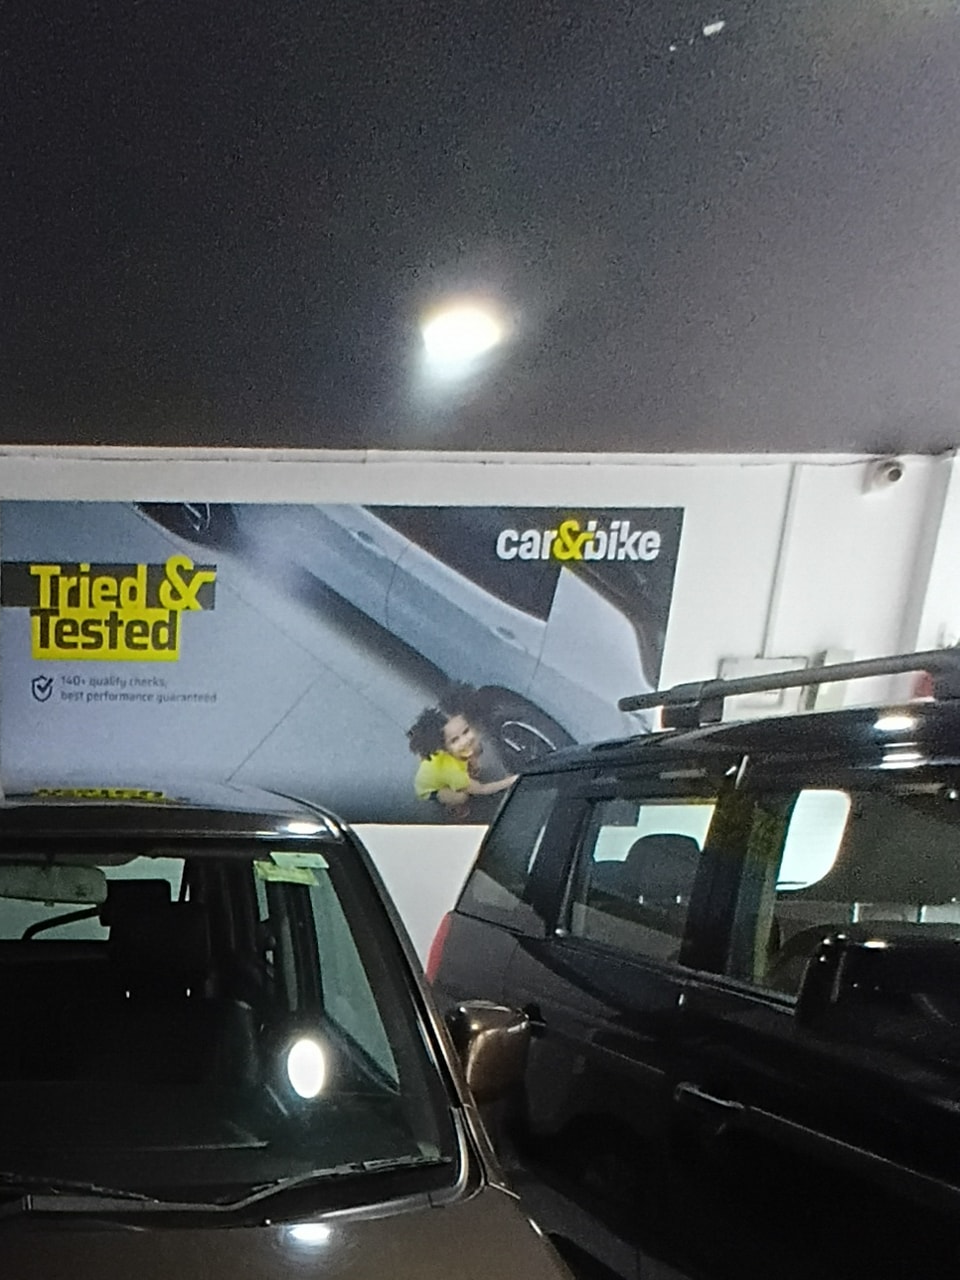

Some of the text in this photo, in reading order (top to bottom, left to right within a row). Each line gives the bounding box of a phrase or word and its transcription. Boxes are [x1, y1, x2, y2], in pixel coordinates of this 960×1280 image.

[496, 520, 661, 560] car&bike
[30, 555, 216, 610] Tried &
[30, 608, 176, 651] Tested
[60, 691, 217, 704] best performance guaranteed
[89, 676, 127, 688] quality
